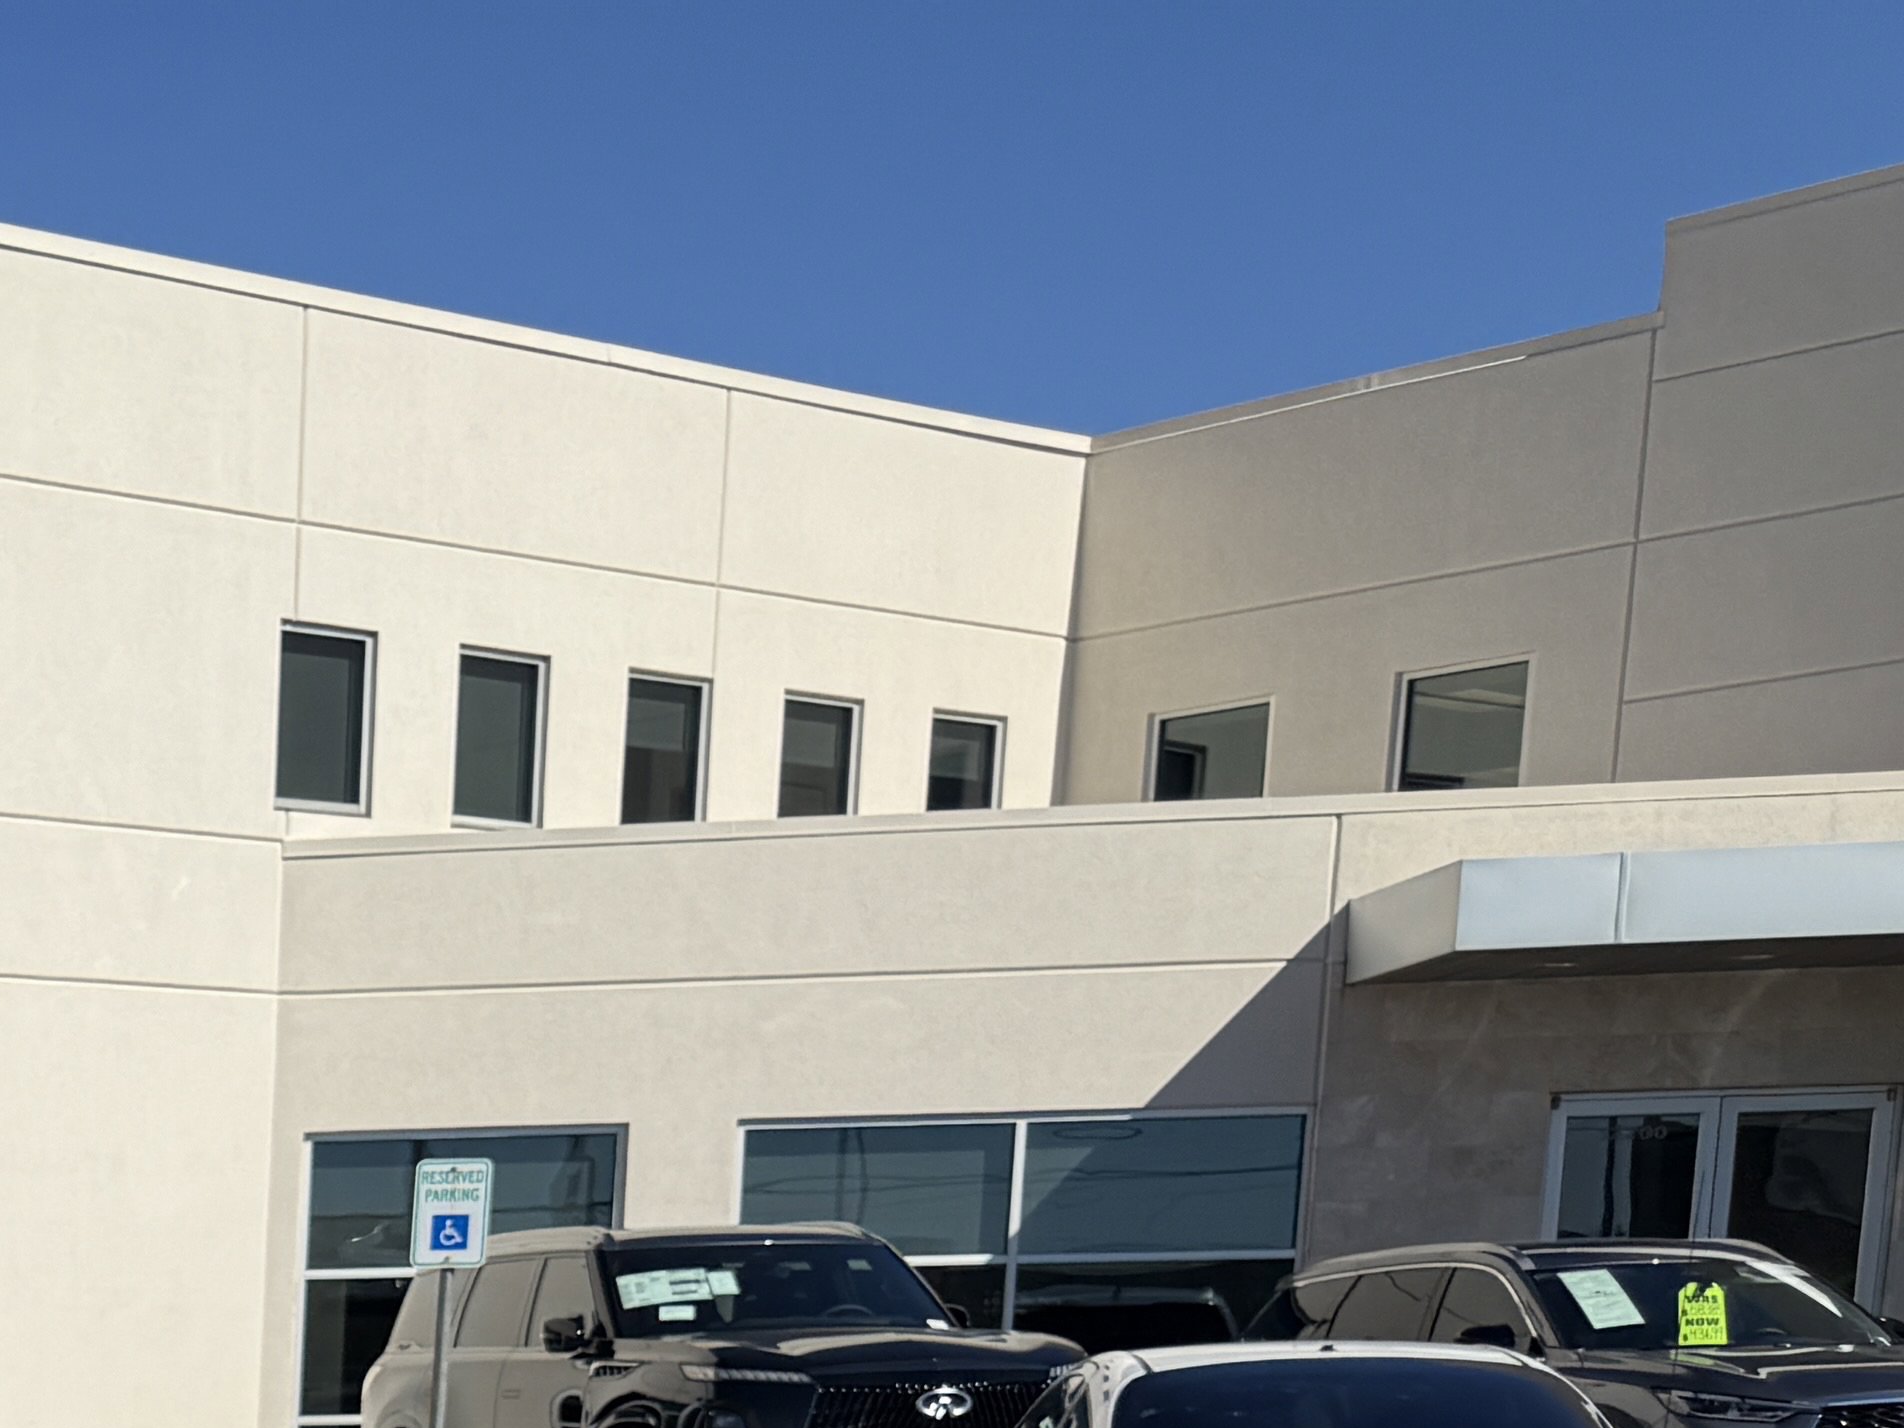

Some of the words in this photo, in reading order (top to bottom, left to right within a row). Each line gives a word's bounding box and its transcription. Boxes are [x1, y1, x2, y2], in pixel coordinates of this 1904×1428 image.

[421, 1170, 485, 1185] RESERVED
[425, 1188, 480, 1203] PARKING
[1685, 1317, 1719, 1326] NOW
